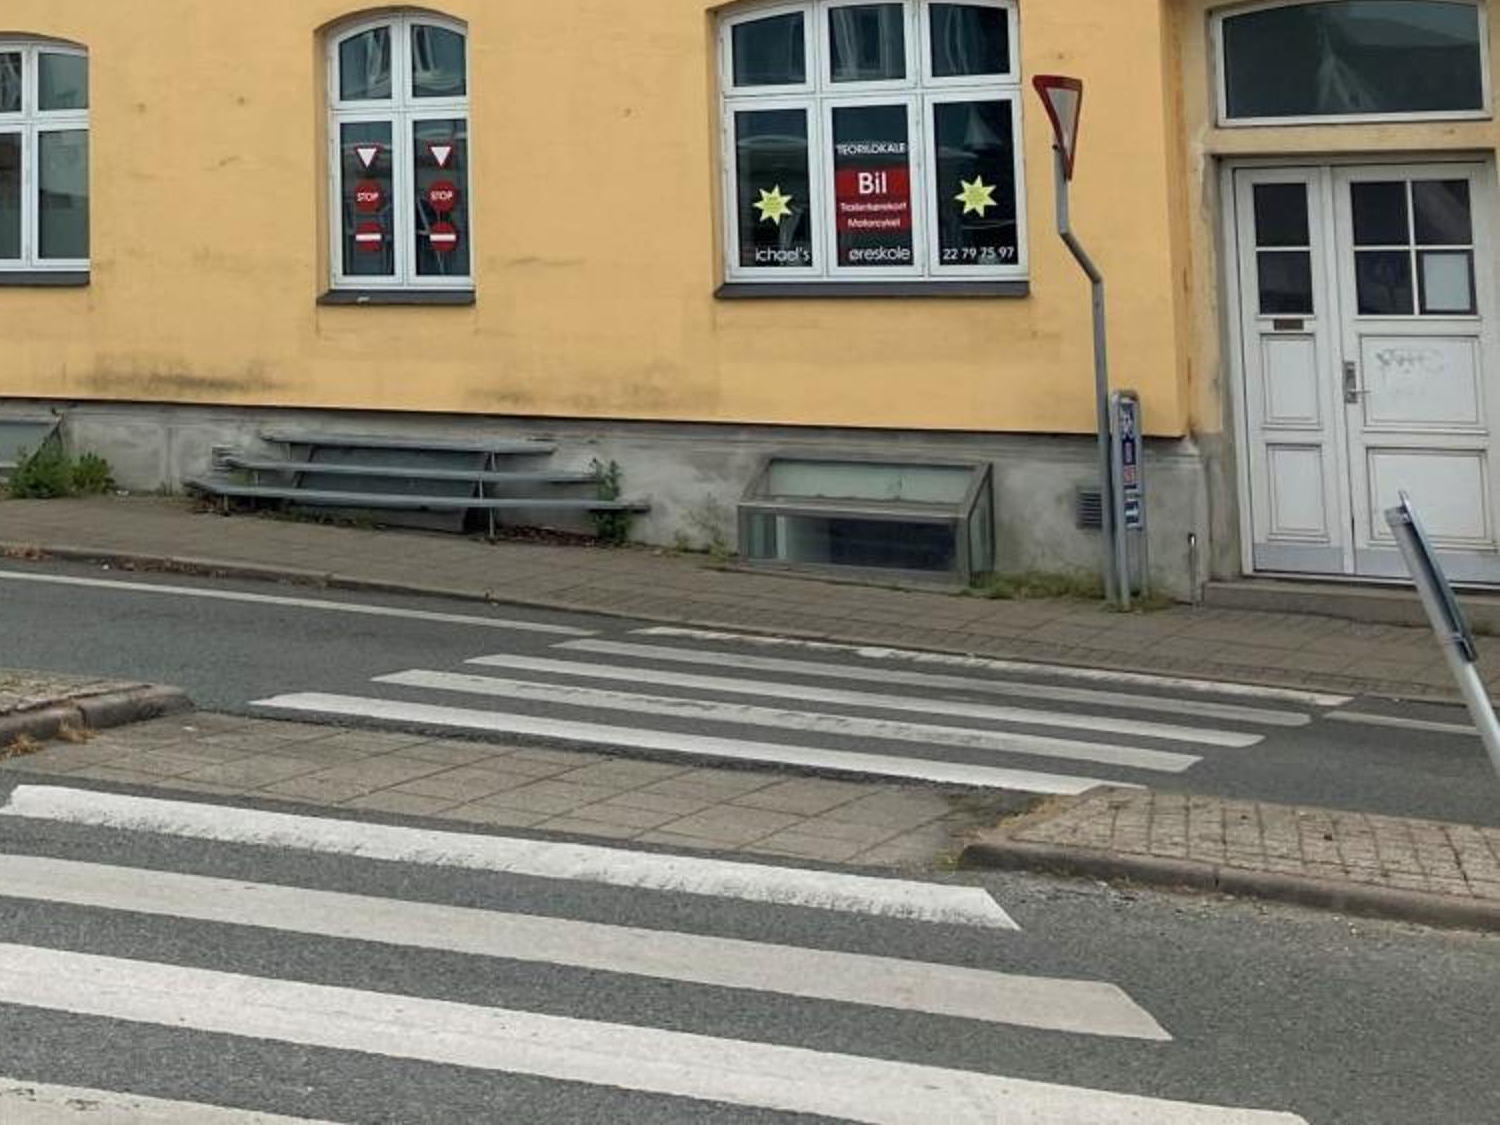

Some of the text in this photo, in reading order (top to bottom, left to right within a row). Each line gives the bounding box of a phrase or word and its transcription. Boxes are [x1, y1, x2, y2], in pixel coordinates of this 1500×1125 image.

[857, 171, 887, 194] Bil
[357, 192, 379, 201] STOP
[430, 190, 453, 200] STOP
[943, 248, 959, 260] 22
[962, 247, 978, 260] 79
[980, 246, 997, 260] 75
[999, 246, 1014, 259] 97
